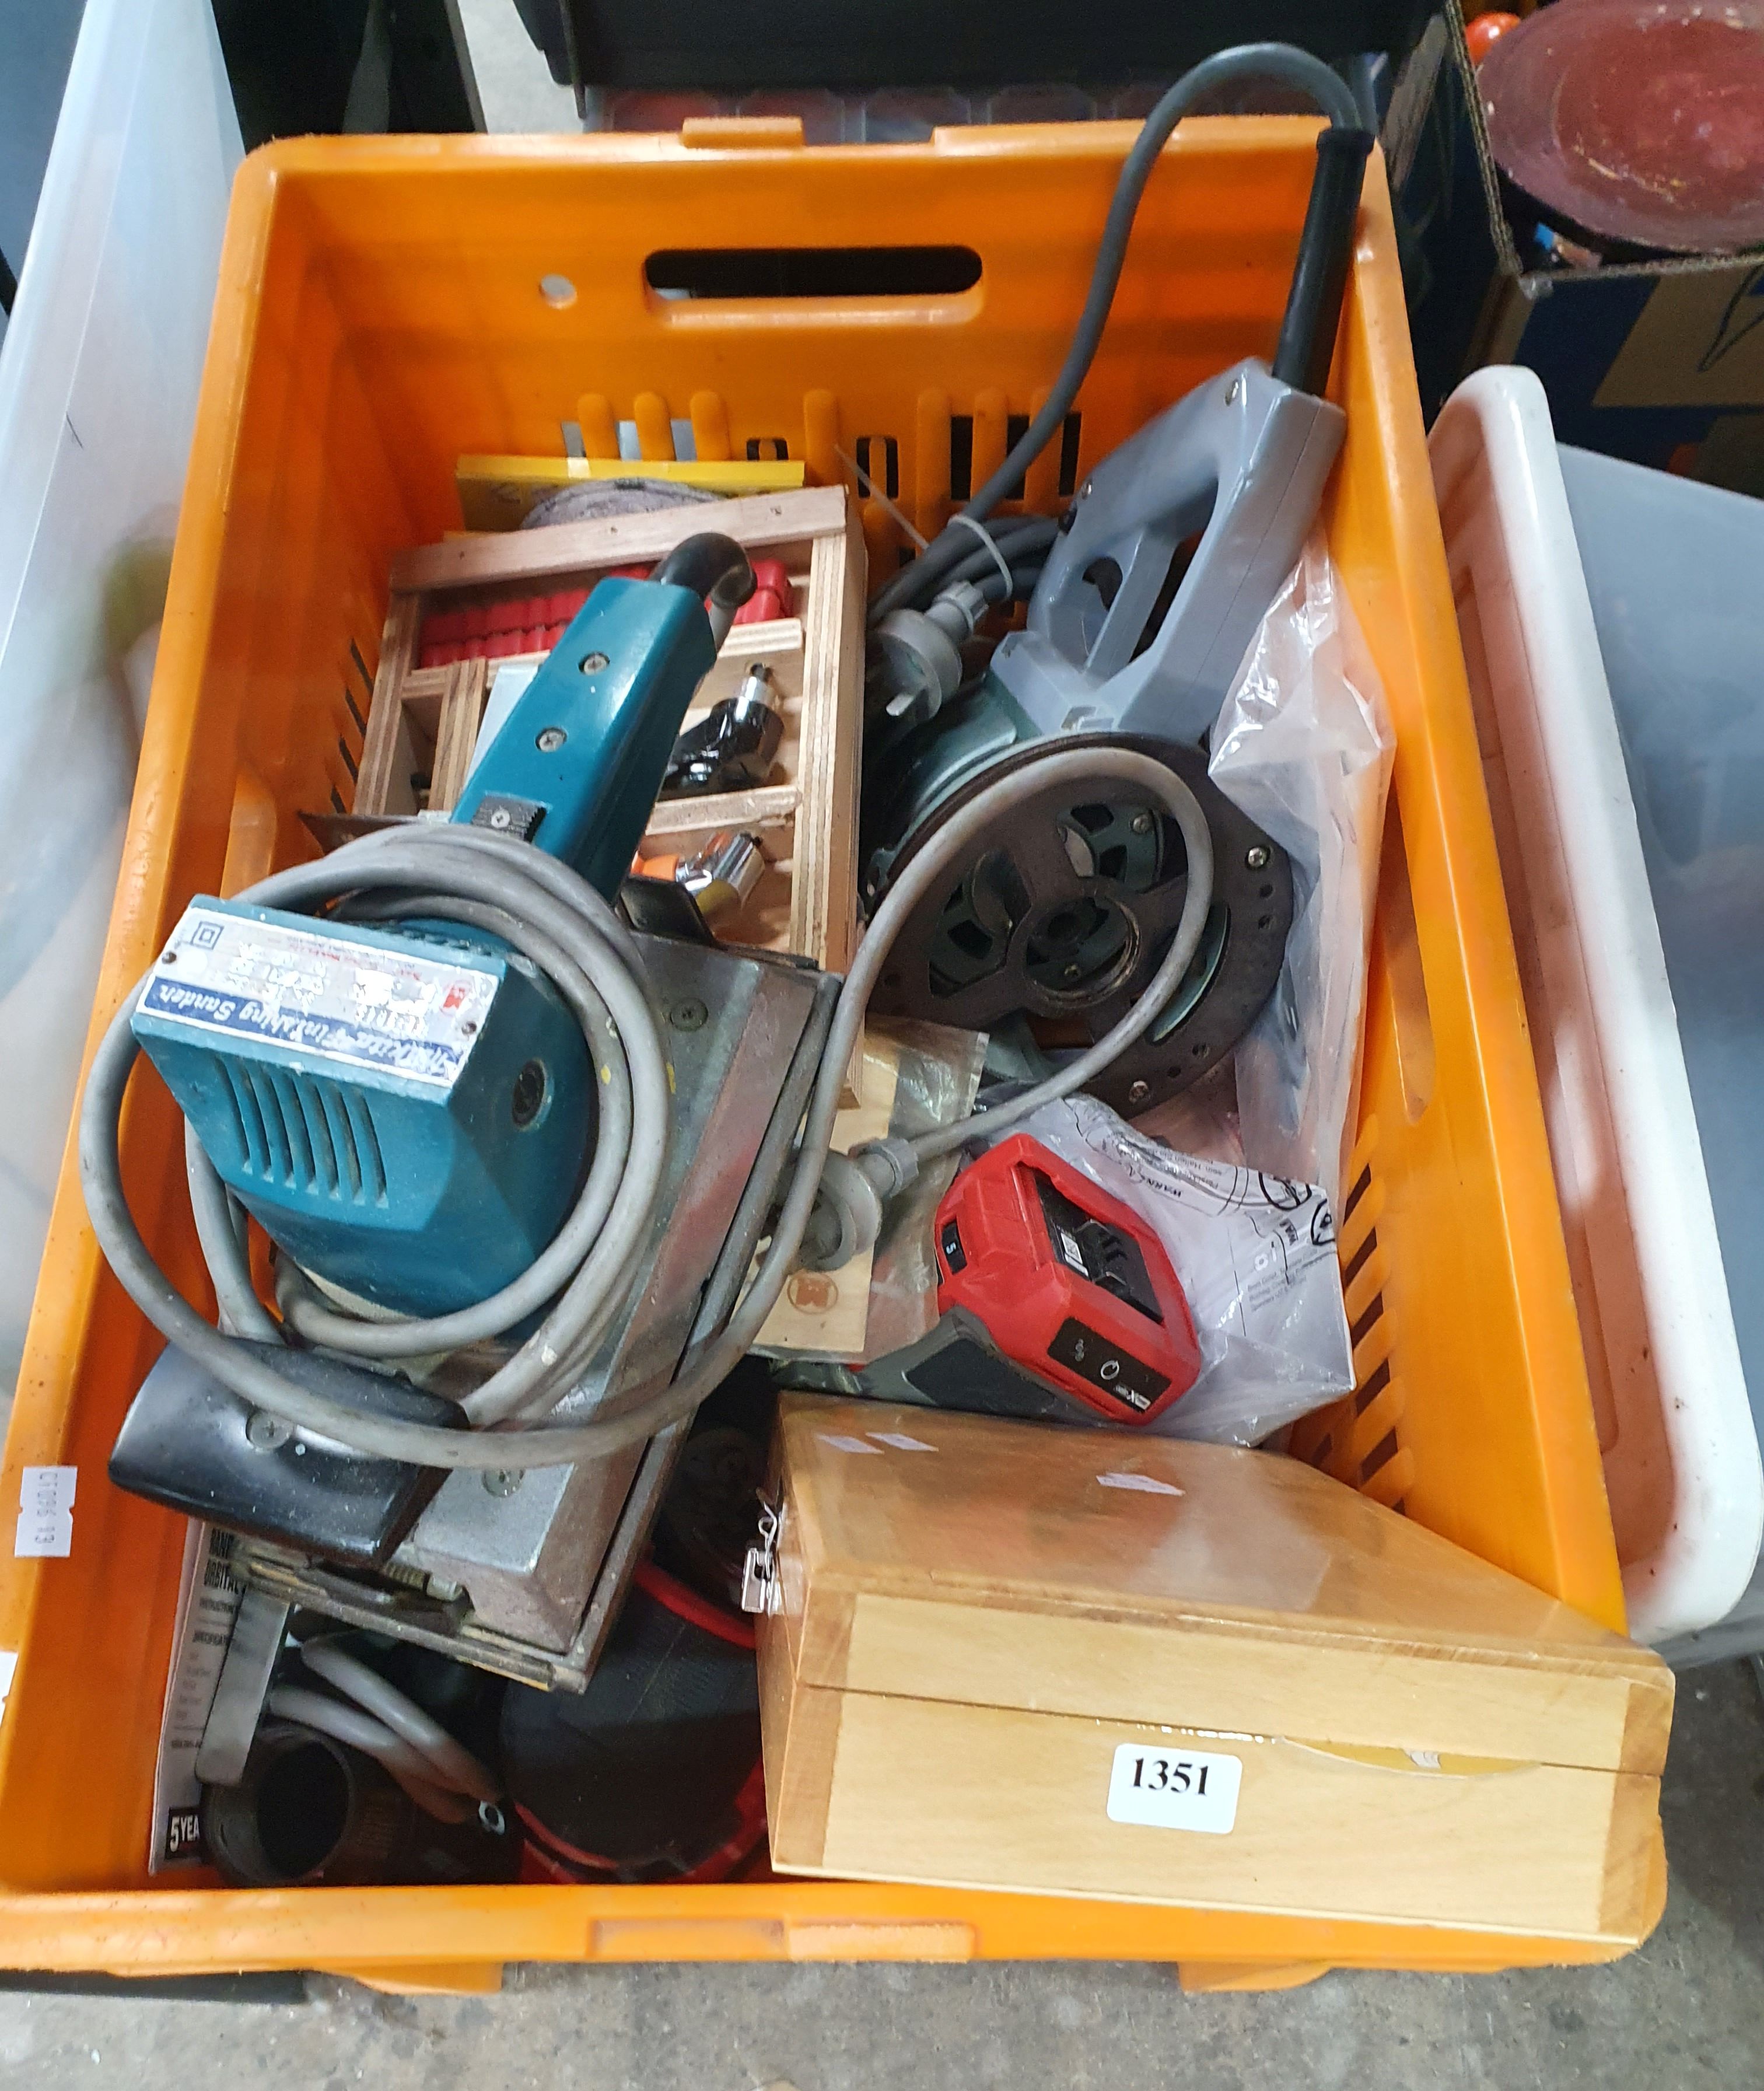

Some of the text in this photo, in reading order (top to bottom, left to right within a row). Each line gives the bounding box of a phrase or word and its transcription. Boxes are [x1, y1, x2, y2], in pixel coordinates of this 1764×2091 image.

[159, 983, 236, 1022] Sander
[1130, 1757, 1209, 1796] 1351
[170, 1814, 201, 1852] 5 YEA
